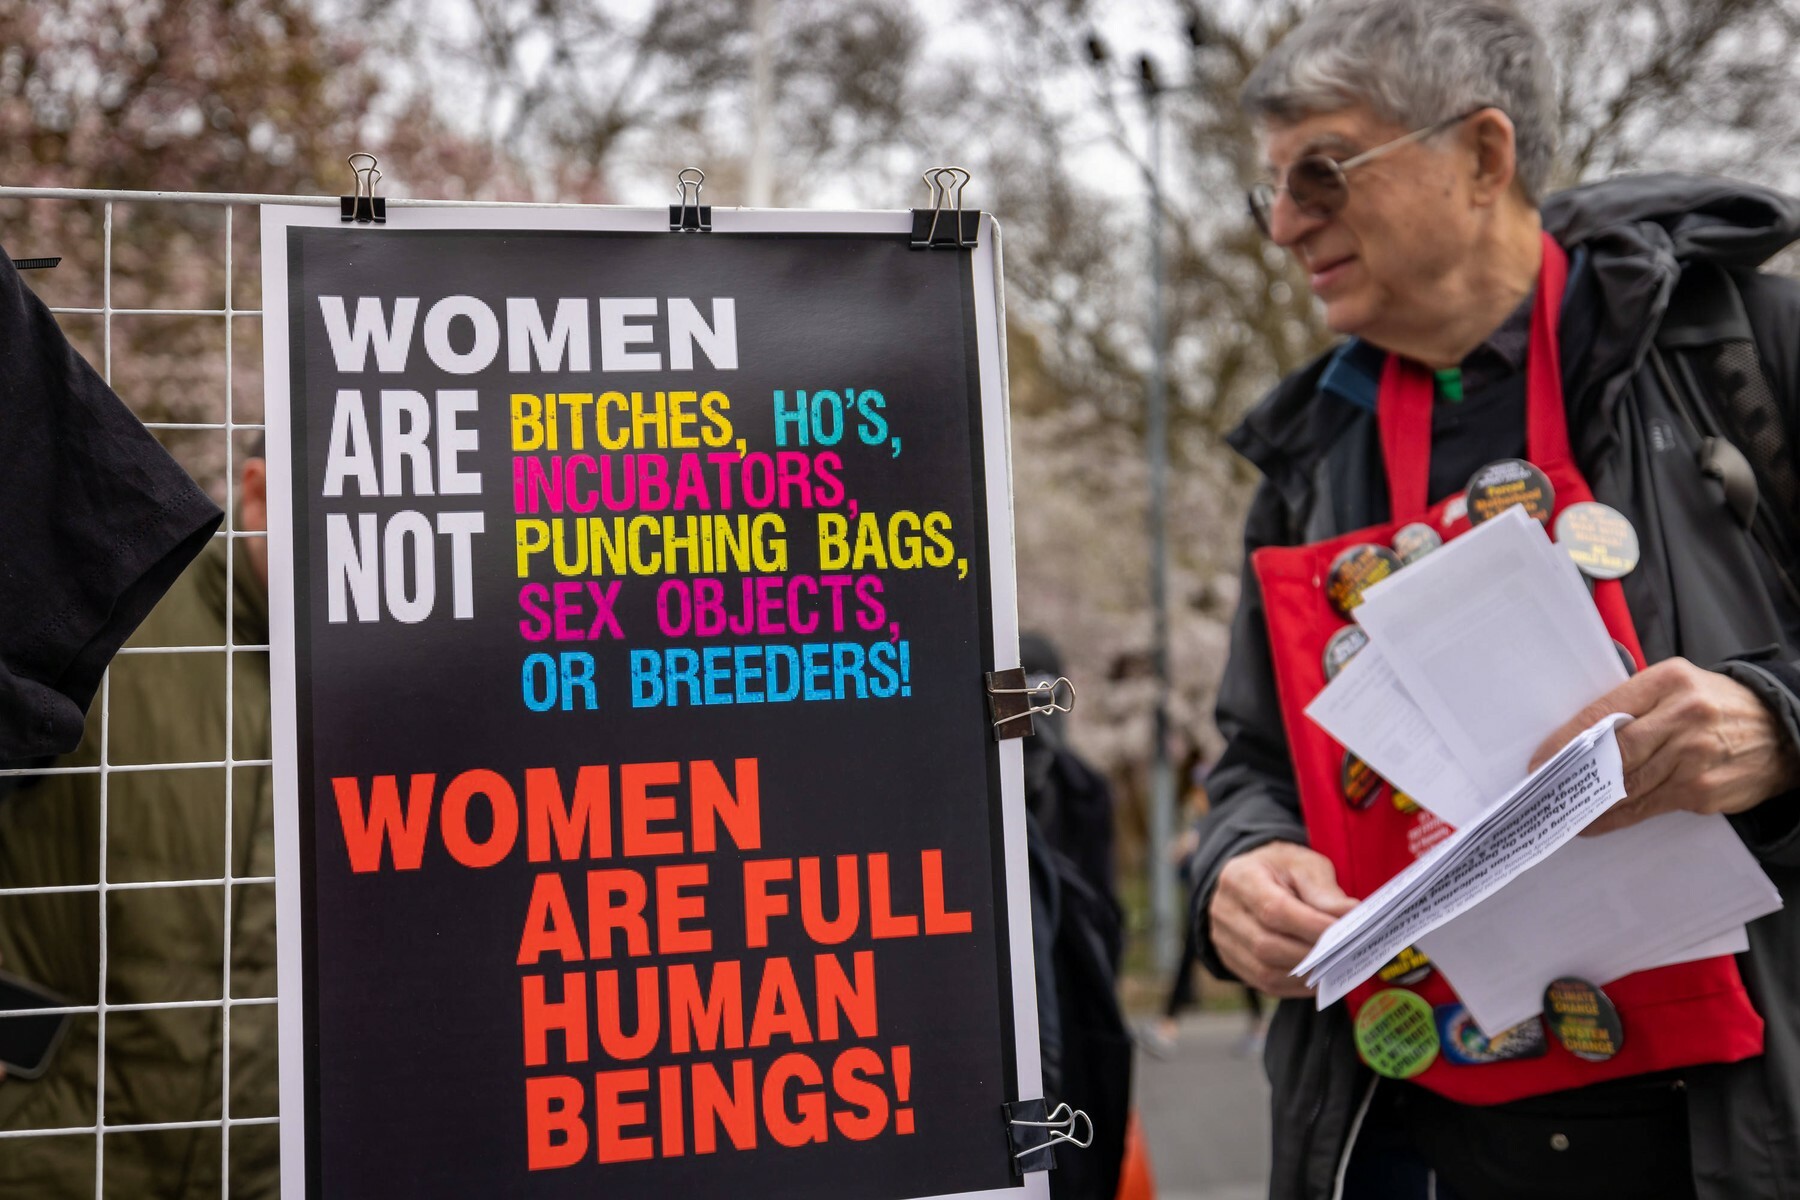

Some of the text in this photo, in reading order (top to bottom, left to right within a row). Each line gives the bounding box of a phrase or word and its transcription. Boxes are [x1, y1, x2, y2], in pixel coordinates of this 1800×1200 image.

[318, 296, 738, 373] WOMEN
[323, 388, 901, 496] ARE BITCHES, HO'S,
[512, 451, 858, 519] INCUBATORS,
[327, 510, 967, 623] NOT PUNCHING BAGS,
[519, 575, 900, 643] SEX OBJECTS,
[522, 640, 911, 712] OR BREEDERS!
[332, 758, 761, 873] WOMEN
[517, 849, 972, 965] ARE FULL
[522, 950, 878, 1066] HUMAN
[526, 1045, 915, 1170] BEINGS!
